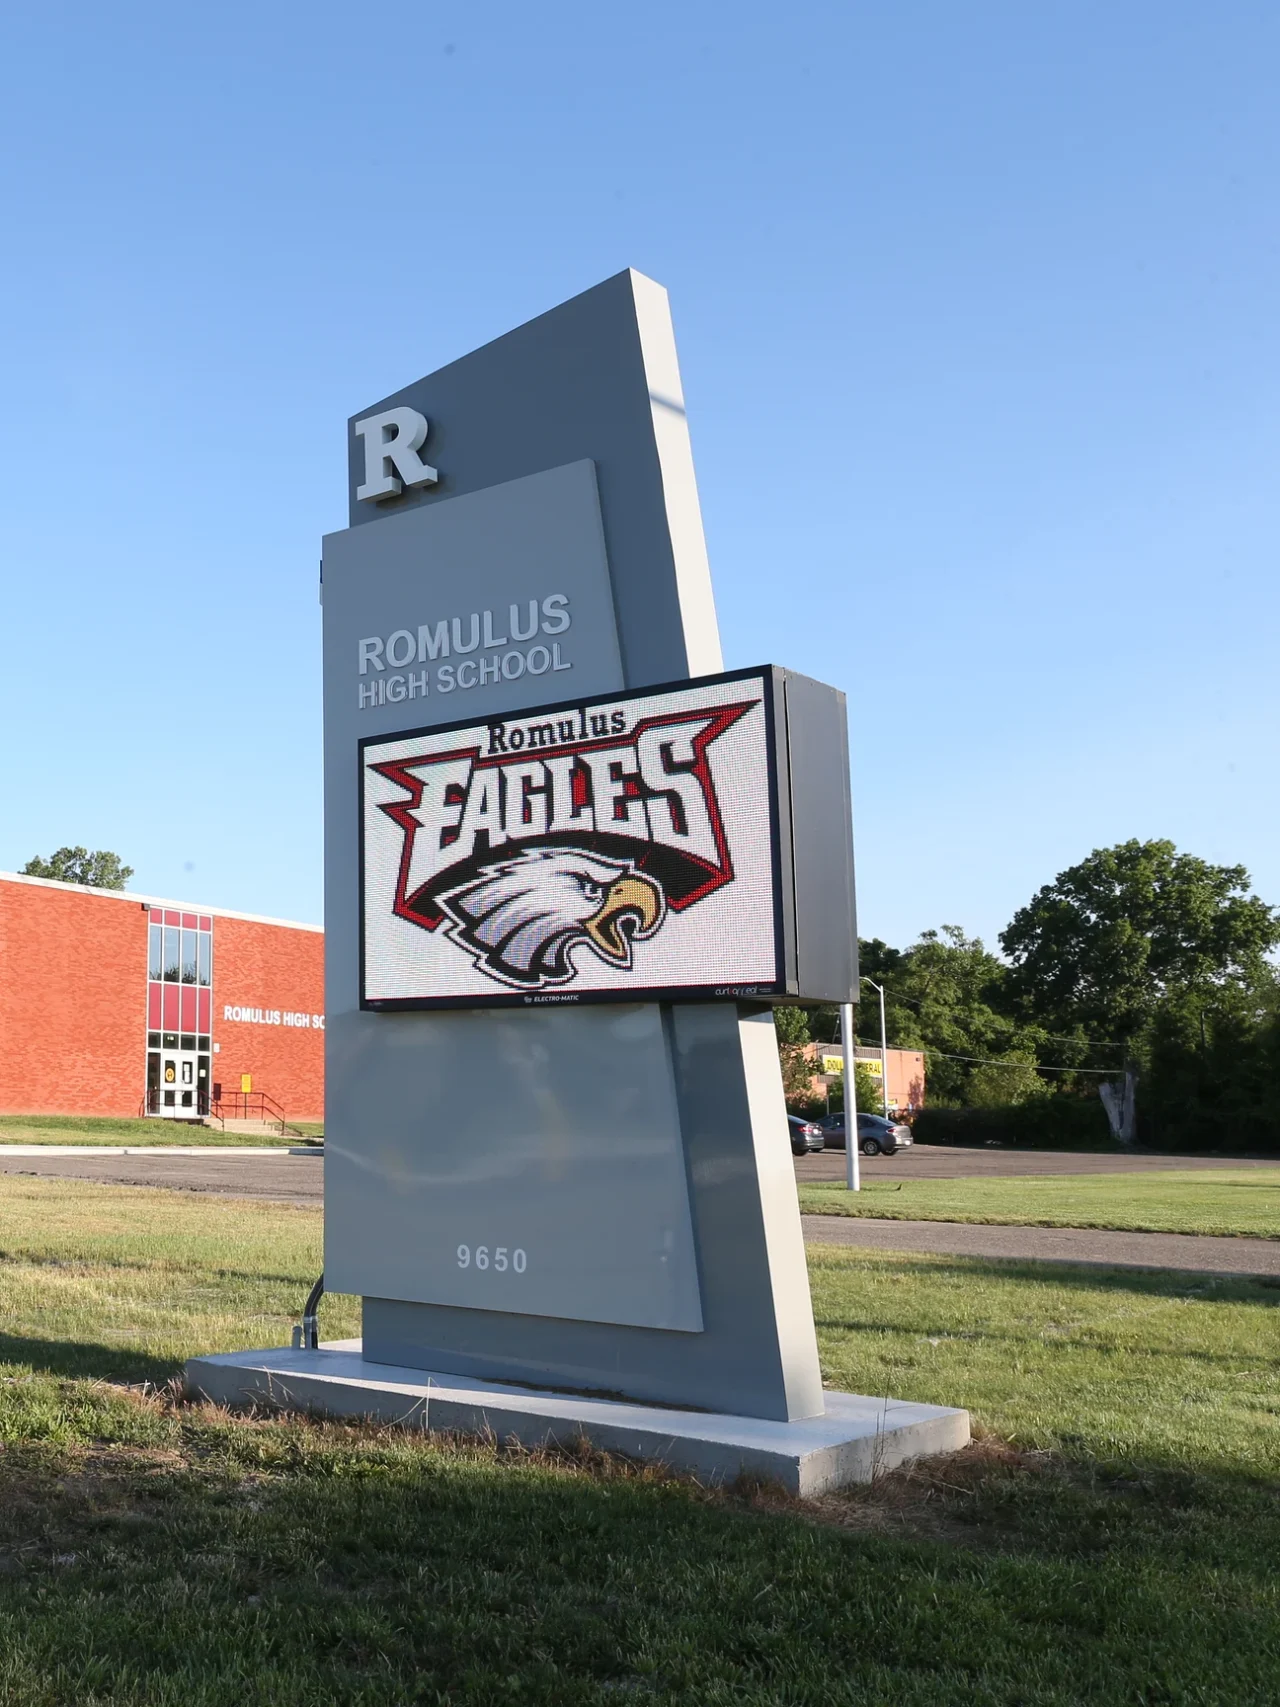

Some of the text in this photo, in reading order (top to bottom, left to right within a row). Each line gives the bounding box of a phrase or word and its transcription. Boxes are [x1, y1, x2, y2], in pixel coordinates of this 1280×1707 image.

[355, 406, 438, 500] R
[358, 594, 571, 675] ROMULUS
[358, 642, 572, 709] HIGH SCHOOL
[488, 708, 626, 754] Romulus
[404, 717, 721, 892] EAGLES
[224, 1005, 281, 1025] ROMULUS
[283, 1011, 310, 1028] HIGH
[533, 995, 579, 1003] ELECTRO-MATIC
[827, 1059, 843, 1071] DOLL
[457, 1244, 527, 1273] 9650
